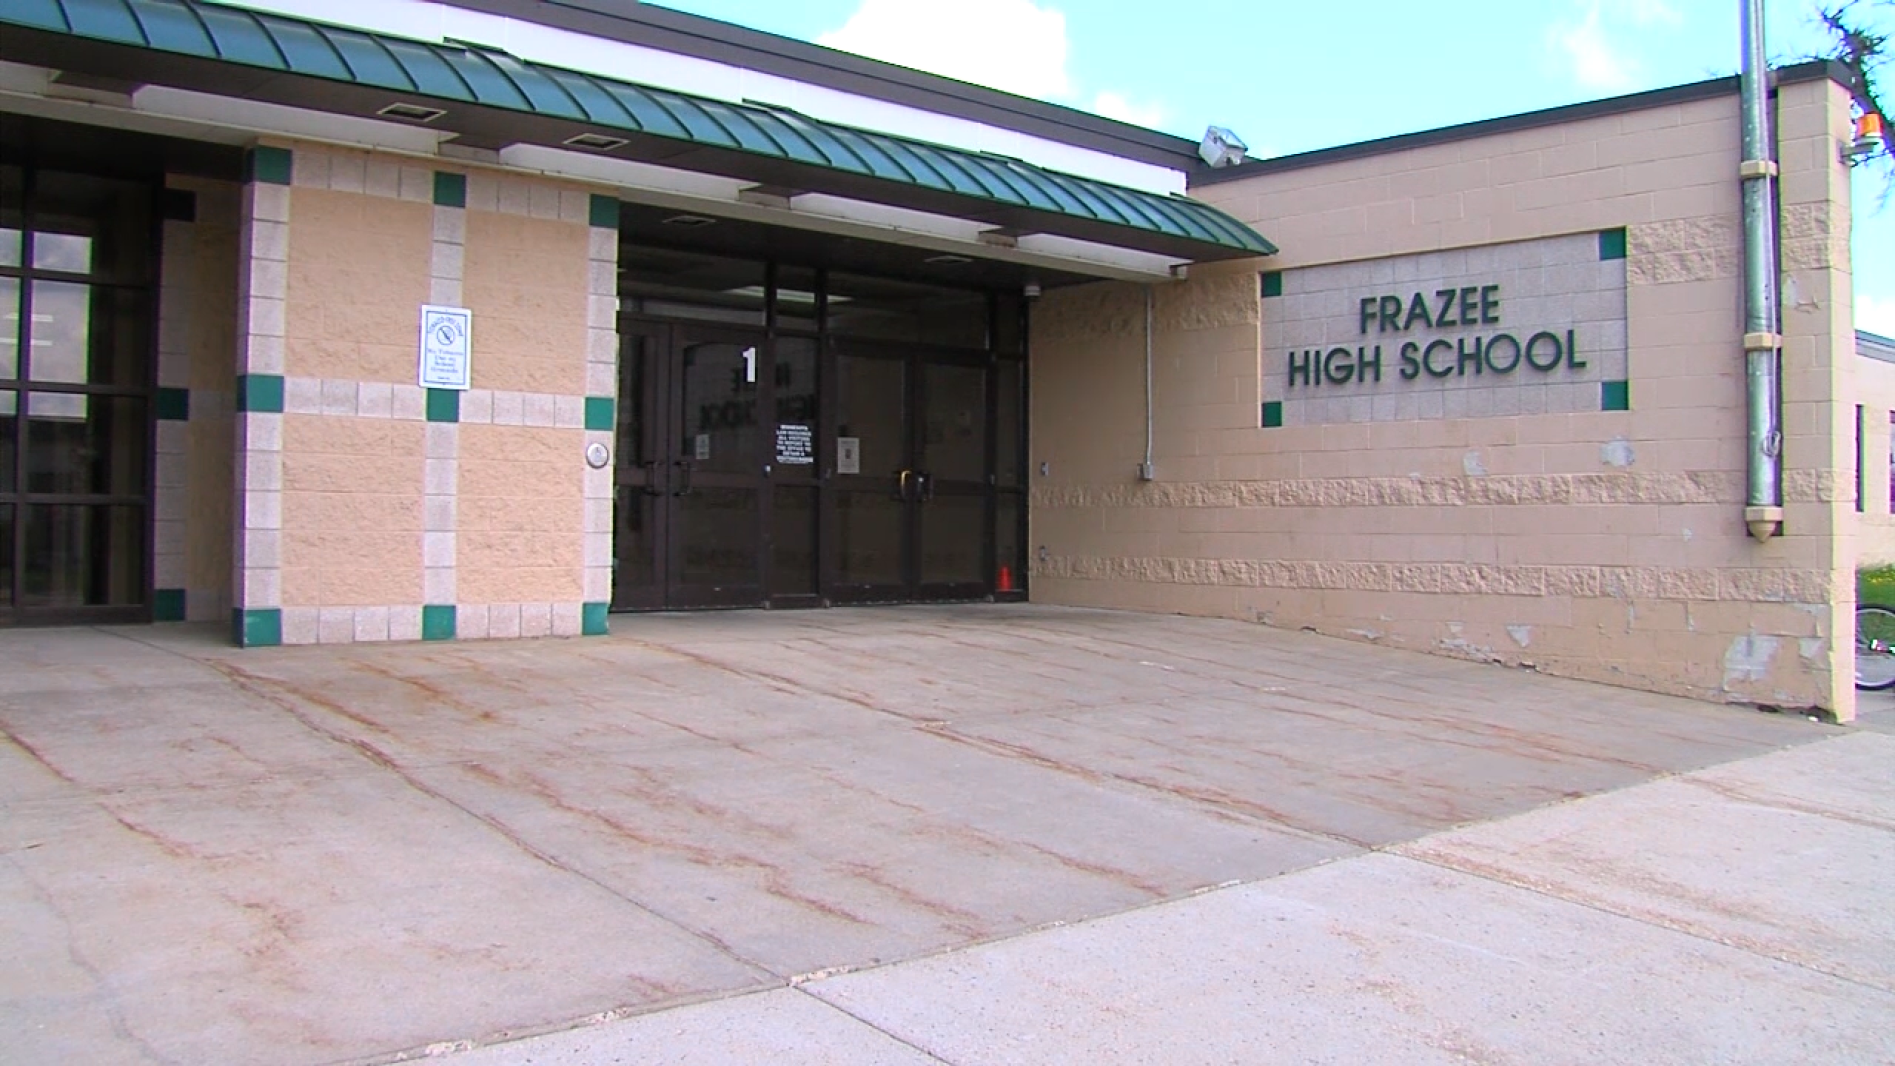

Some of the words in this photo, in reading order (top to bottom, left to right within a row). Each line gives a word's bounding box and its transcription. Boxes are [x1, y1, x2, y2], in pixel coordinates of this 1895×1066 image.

[1360, 284, 1500, 334] FRAZEE
[742, 347, 756, 383] 1
[1288, 345, 1382, 387] HIGH
[1399, 329, 1588, 380] SCHOOL
